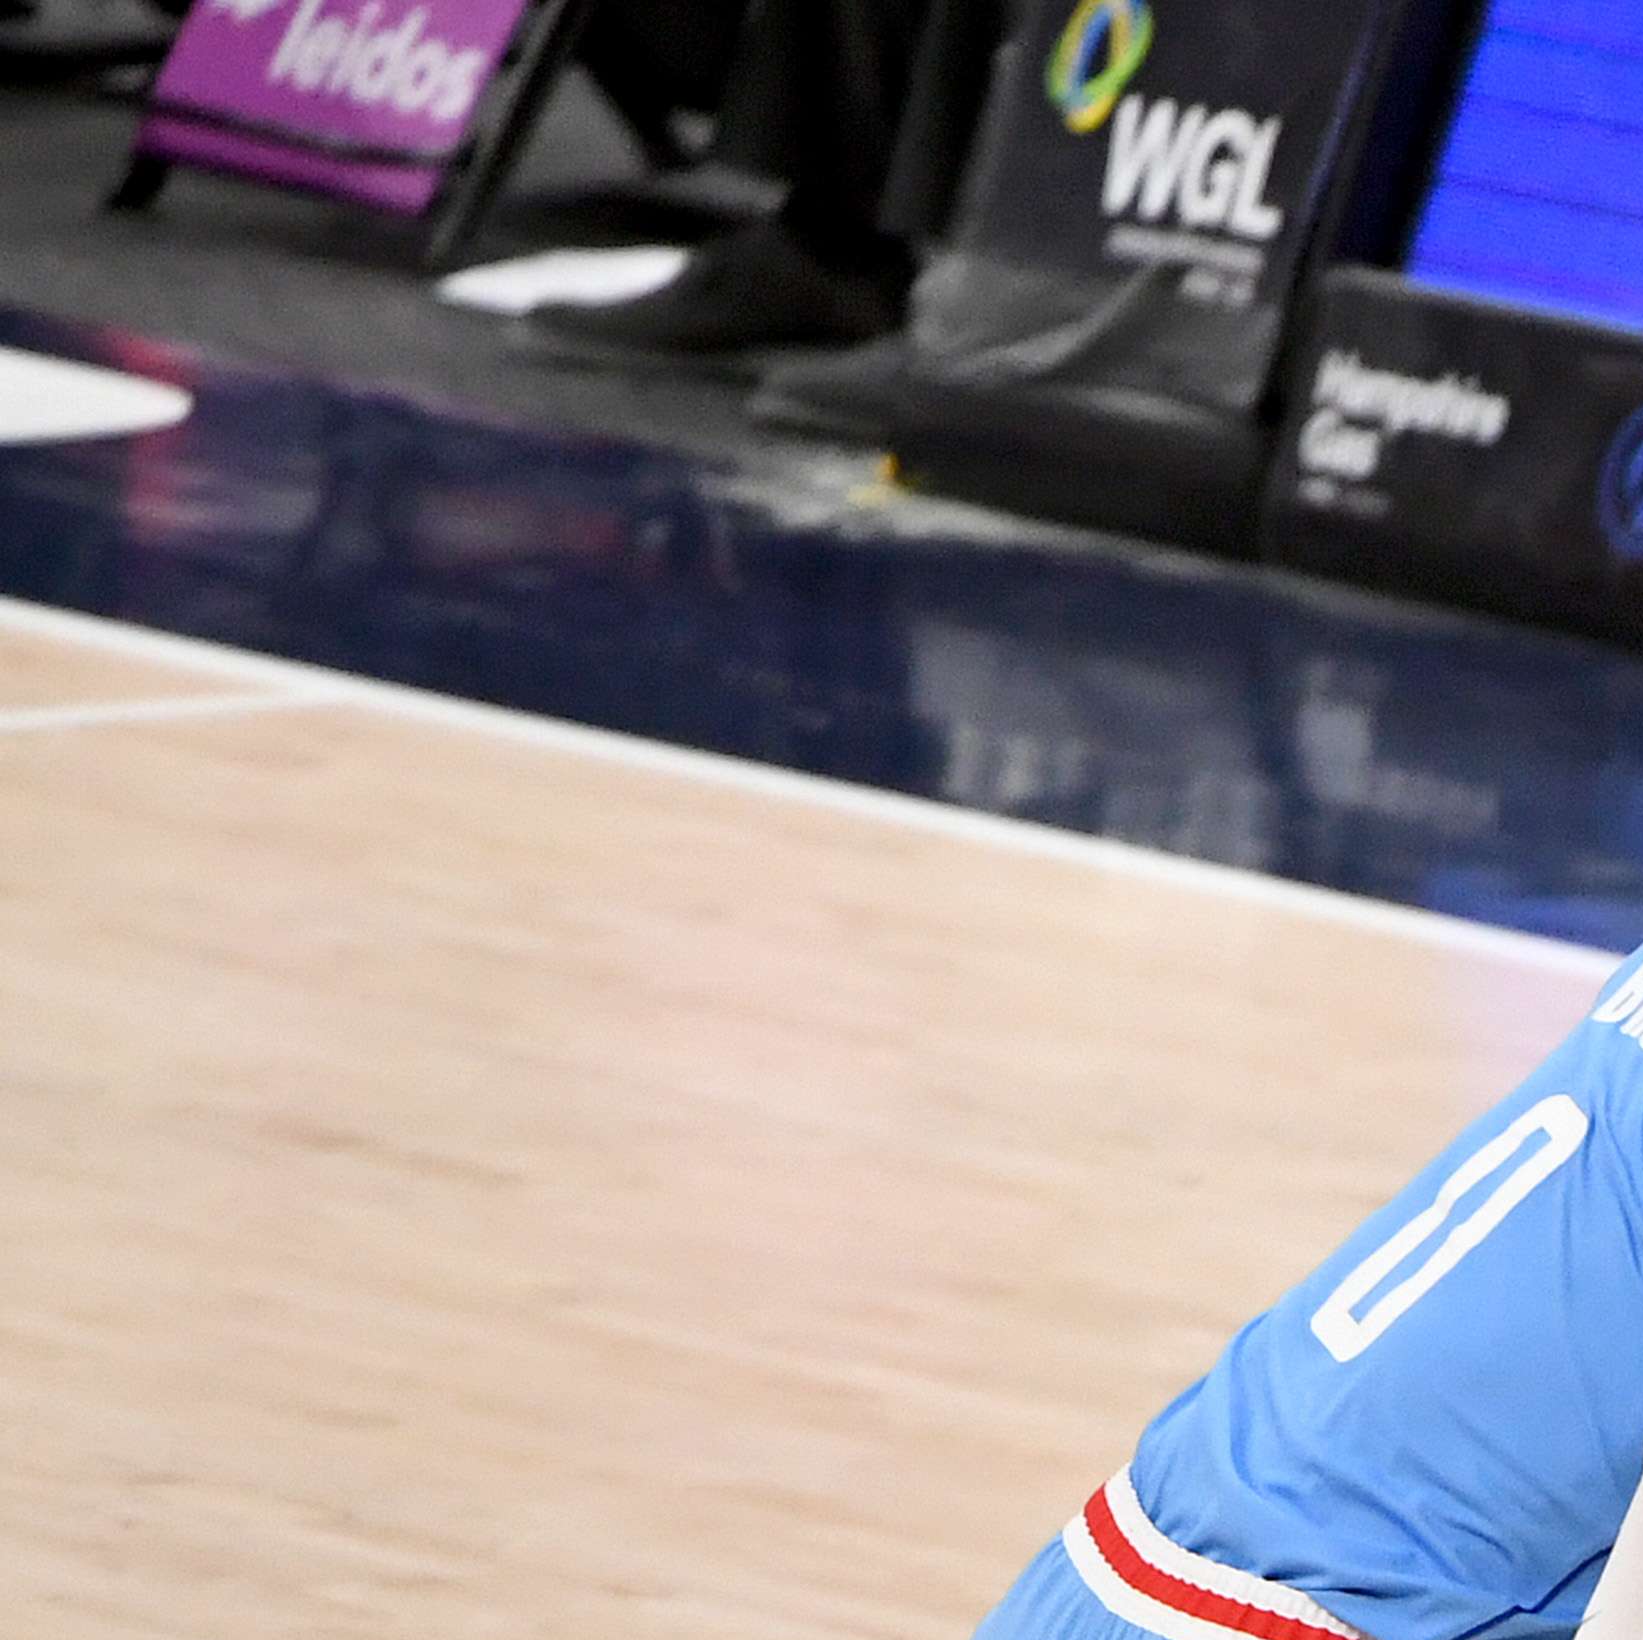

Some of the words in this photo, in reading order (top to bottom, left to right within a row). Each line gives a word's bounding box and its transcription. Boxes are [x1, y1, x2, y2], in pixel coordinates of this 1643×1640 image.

[266, 0, 486, 122] leidos
[1102, 92, 1285, 241] WGL
[1309, 1093, 1590, 1364] 0
